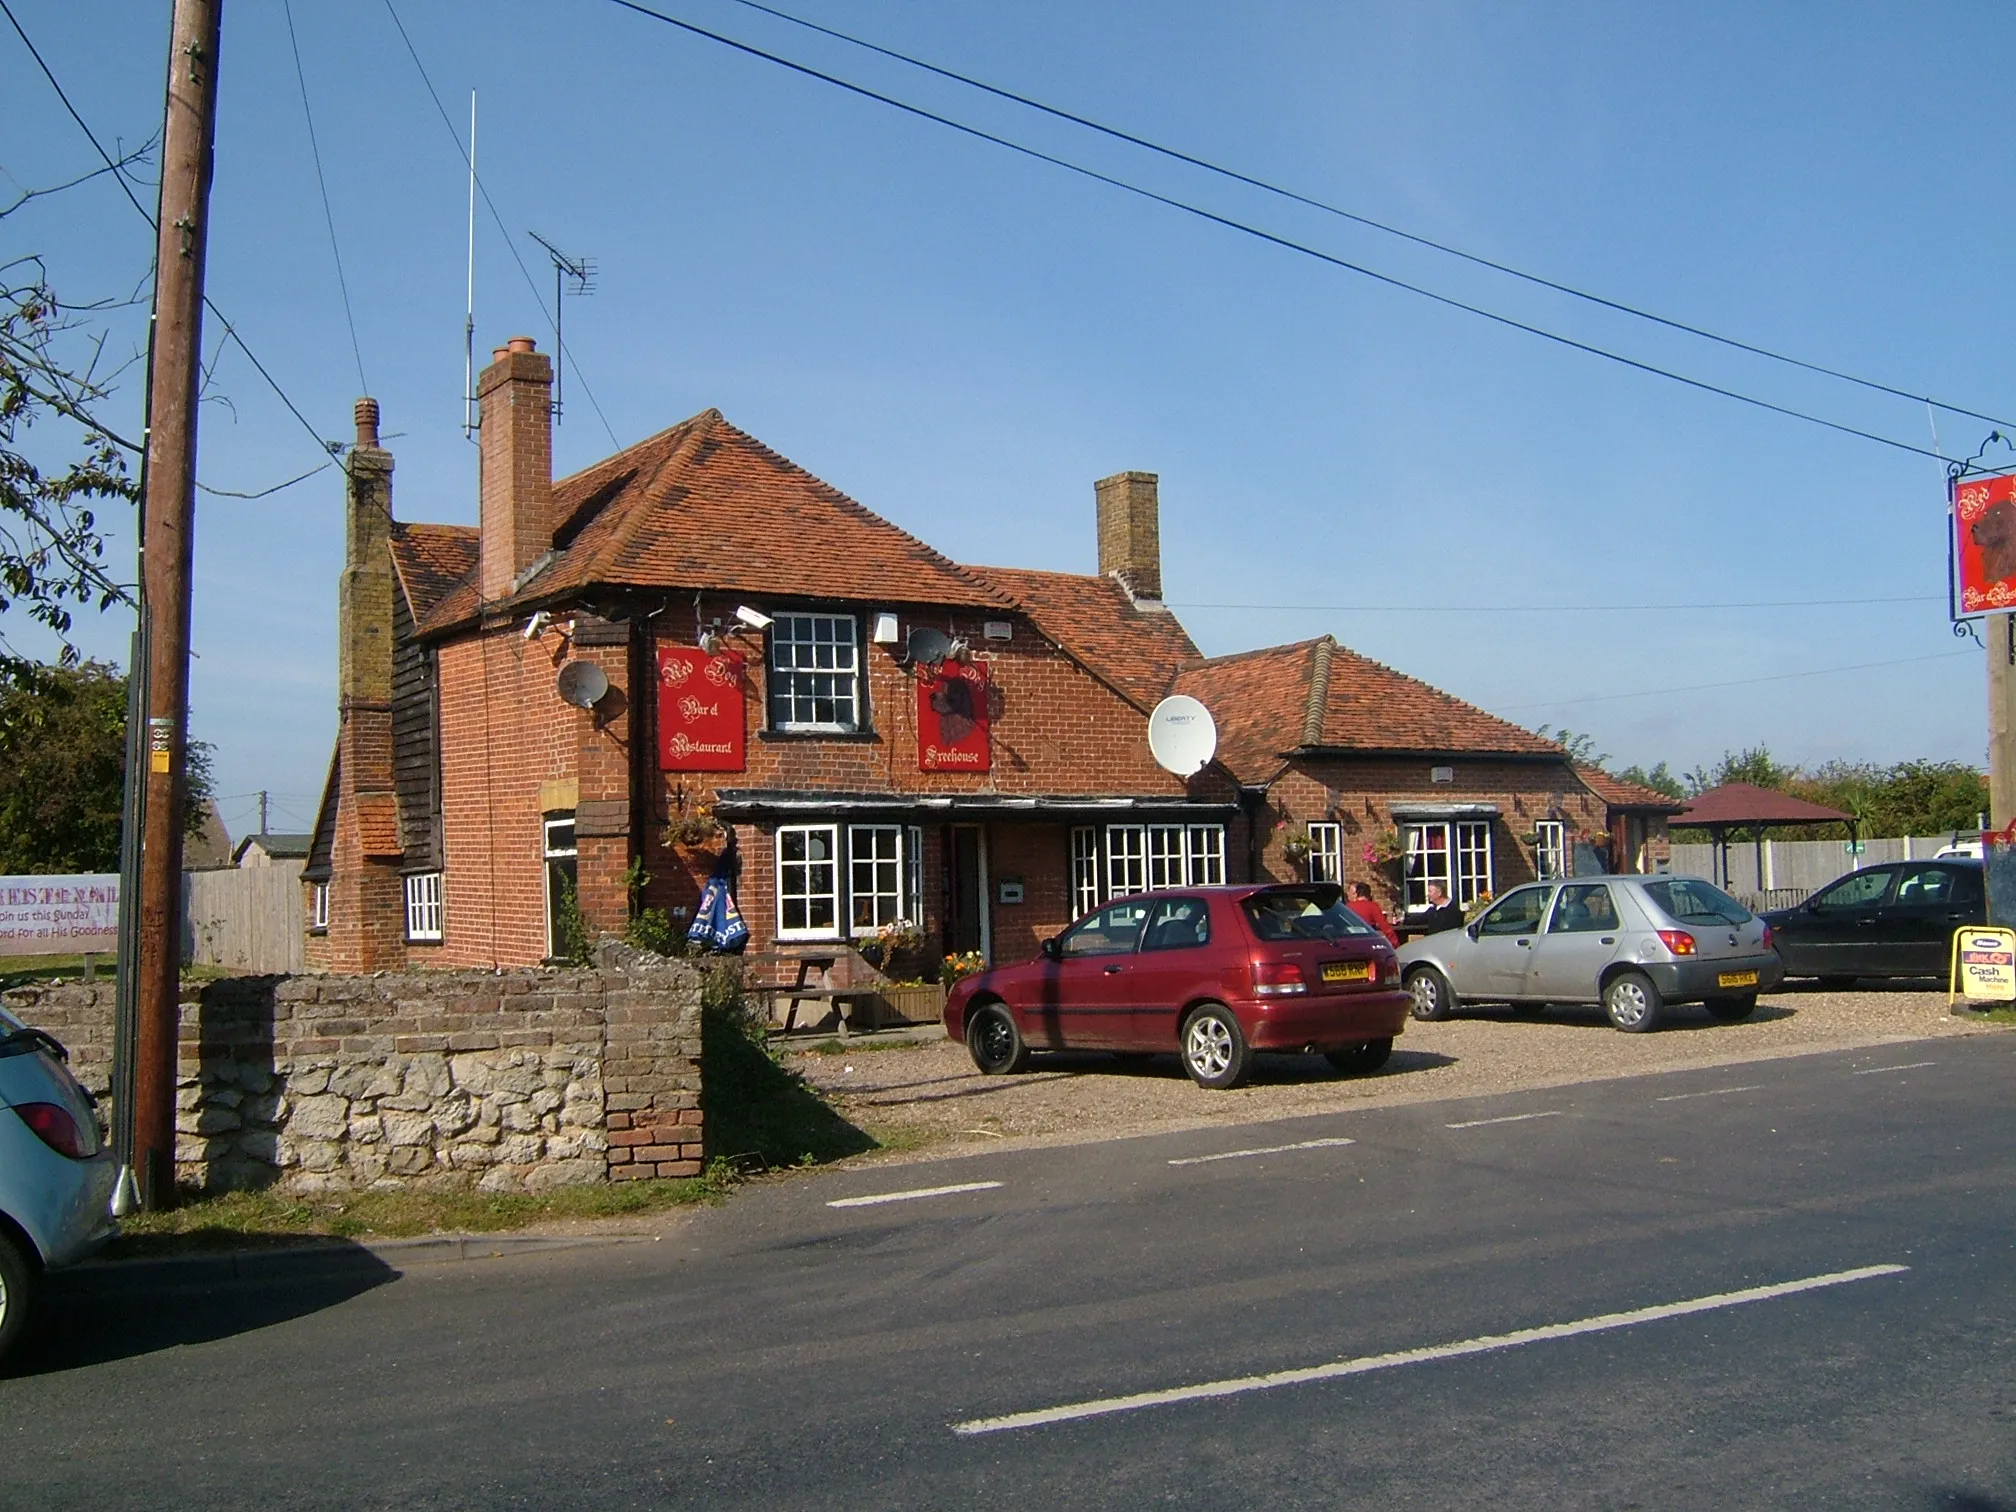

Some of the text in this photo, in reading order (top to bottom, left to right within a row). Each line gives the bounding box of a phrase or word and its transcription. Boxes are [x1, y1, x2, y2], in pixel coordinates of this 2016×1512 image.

[1958, 486, 1990, 520] Red
[1962, 585, 1985, 612] Bar
[661, 656, 737, 688] Red Dog
[677, 694, 709, 724] Bar
[669, 732, 732, 760] Restaurant
[924, 744, 979, 769] Freehouse
[0, 909, 90, 922] oin us this Sunday
[0, 926, 118, 939] ord for all His Goodness
[1969, 966, 2000, 976] Cash
[1979, 976, 2009, 984] Machine
